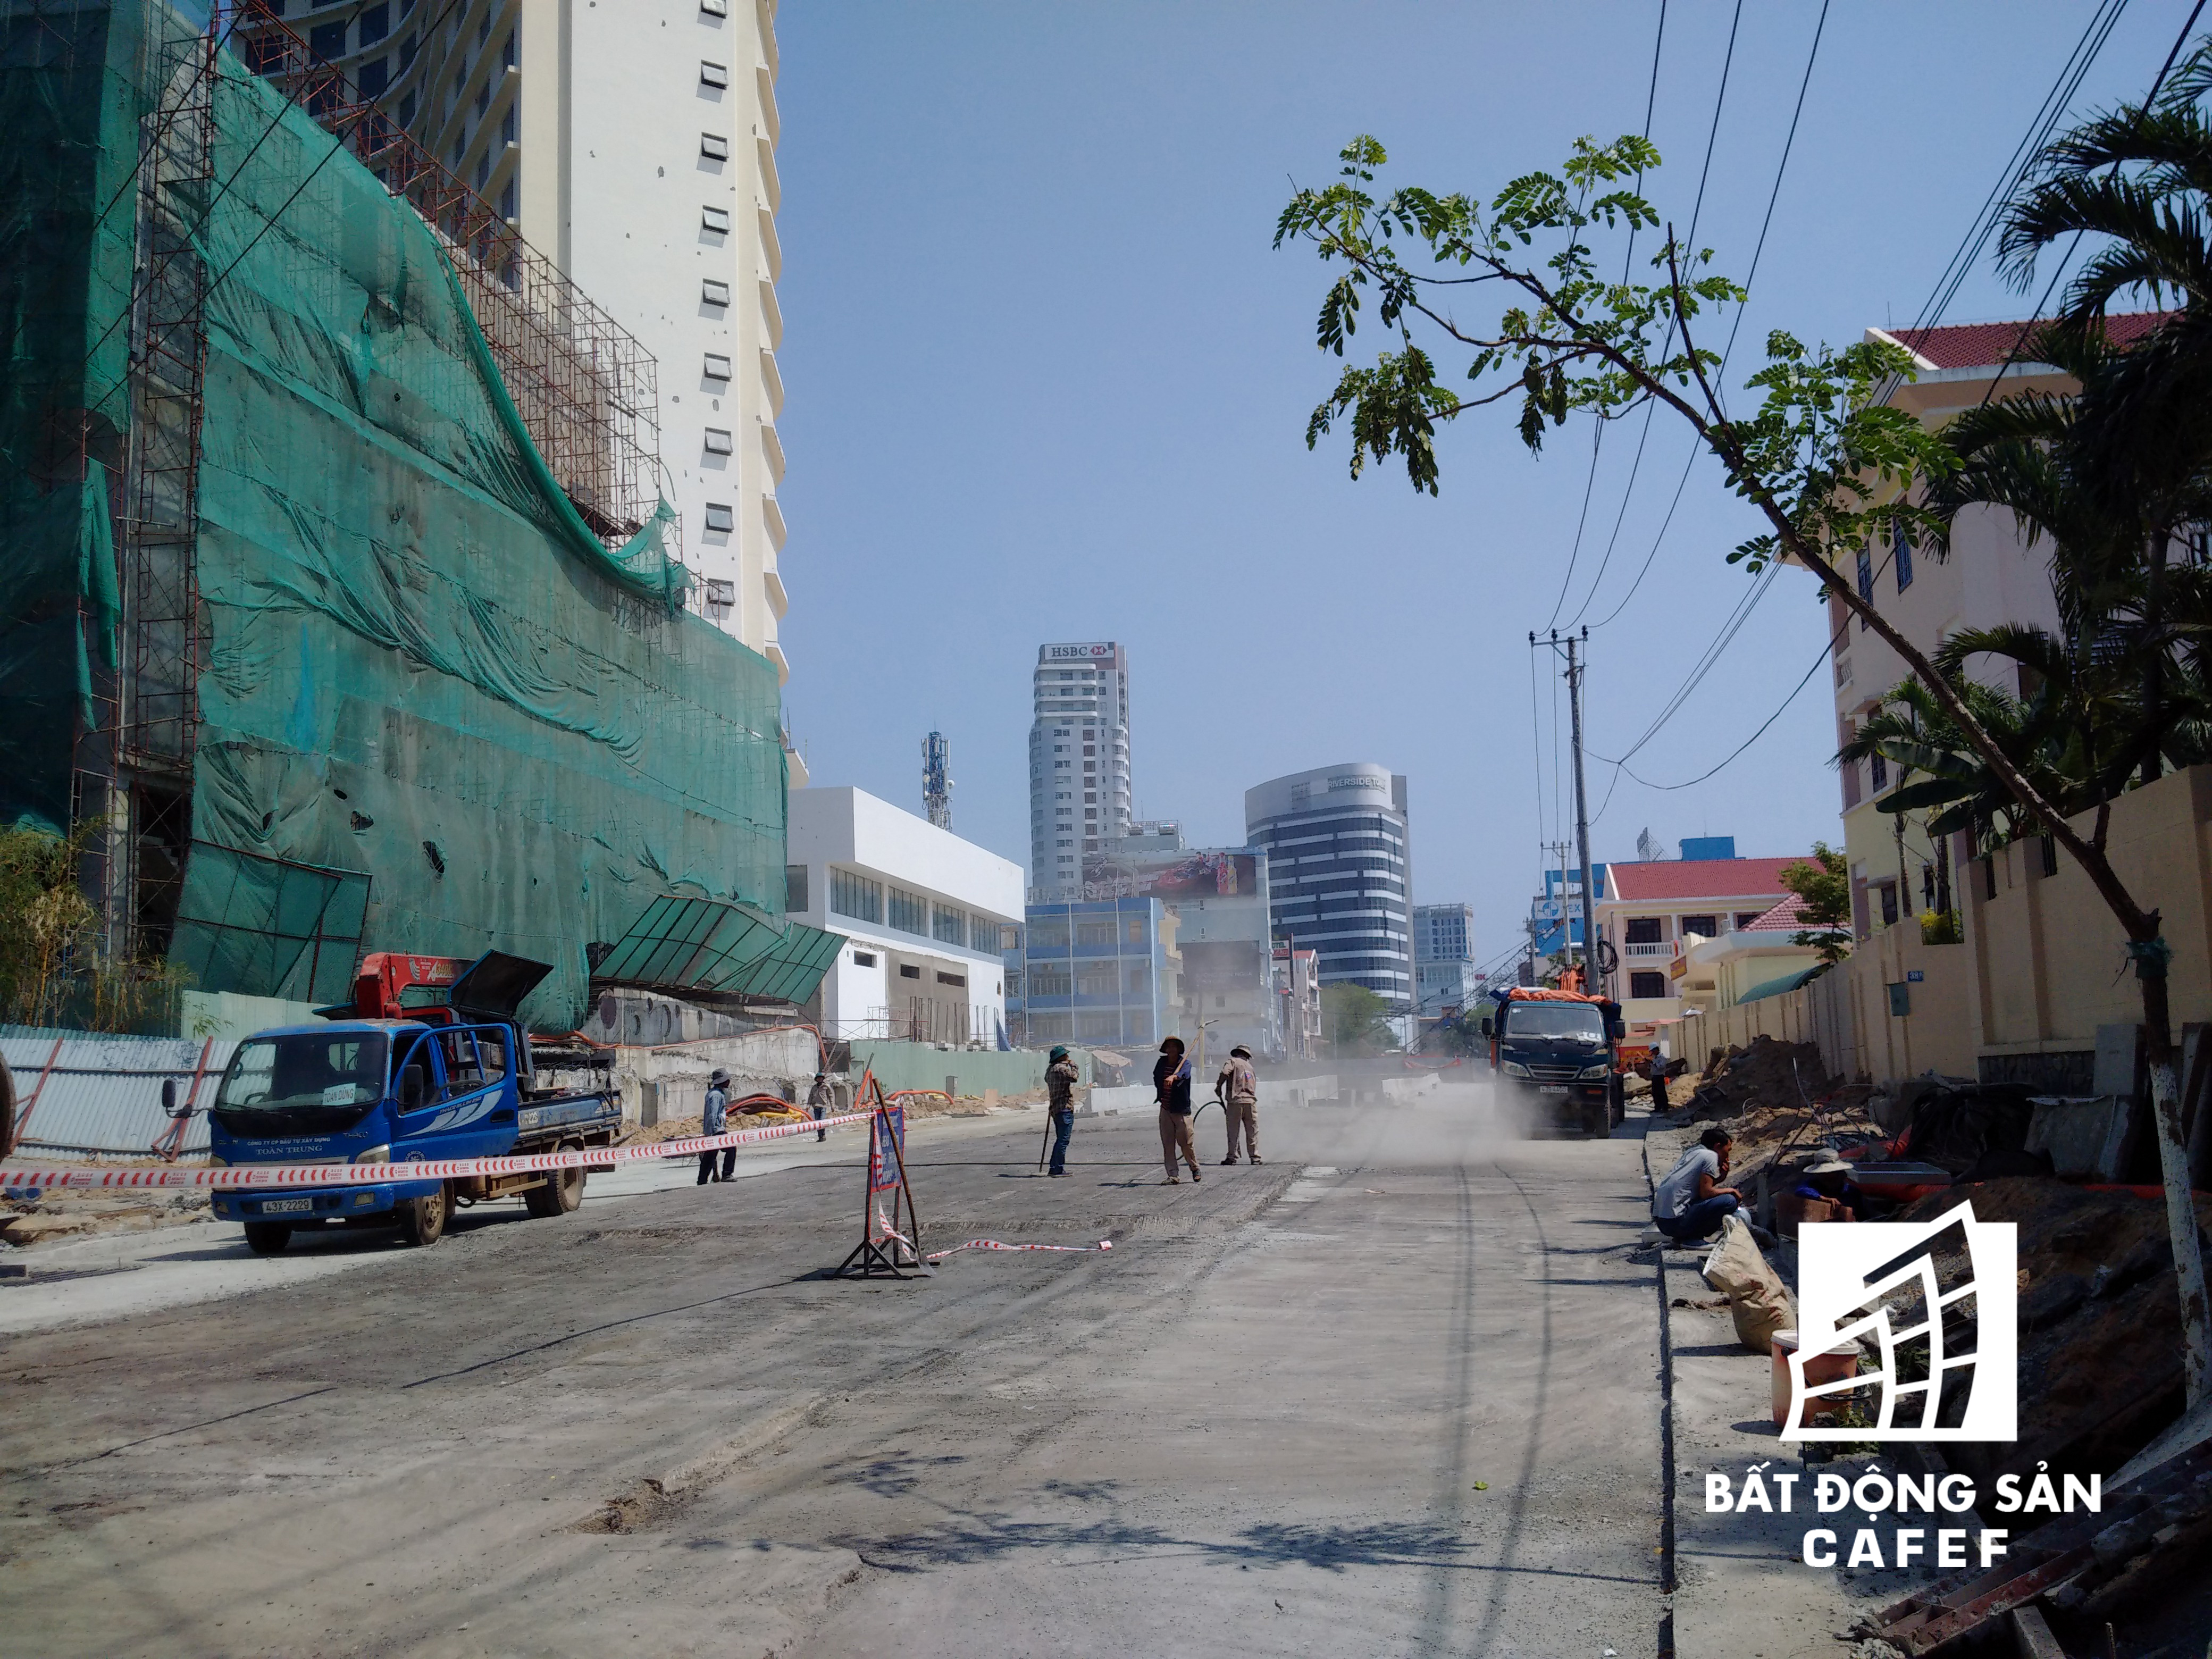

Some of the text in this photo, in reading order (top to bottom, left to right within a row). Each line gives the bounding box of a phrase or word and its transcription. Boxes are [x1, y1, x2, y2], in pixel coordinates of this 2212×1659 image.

[1052, 647, 1087, 657] HSBC
[1328, 778, 1370, 789] RIVERSIDE
[256, 1145, 323, 1155] TOÀN TRUNG
[266, 1200, 308, 1212] 43X-2229
